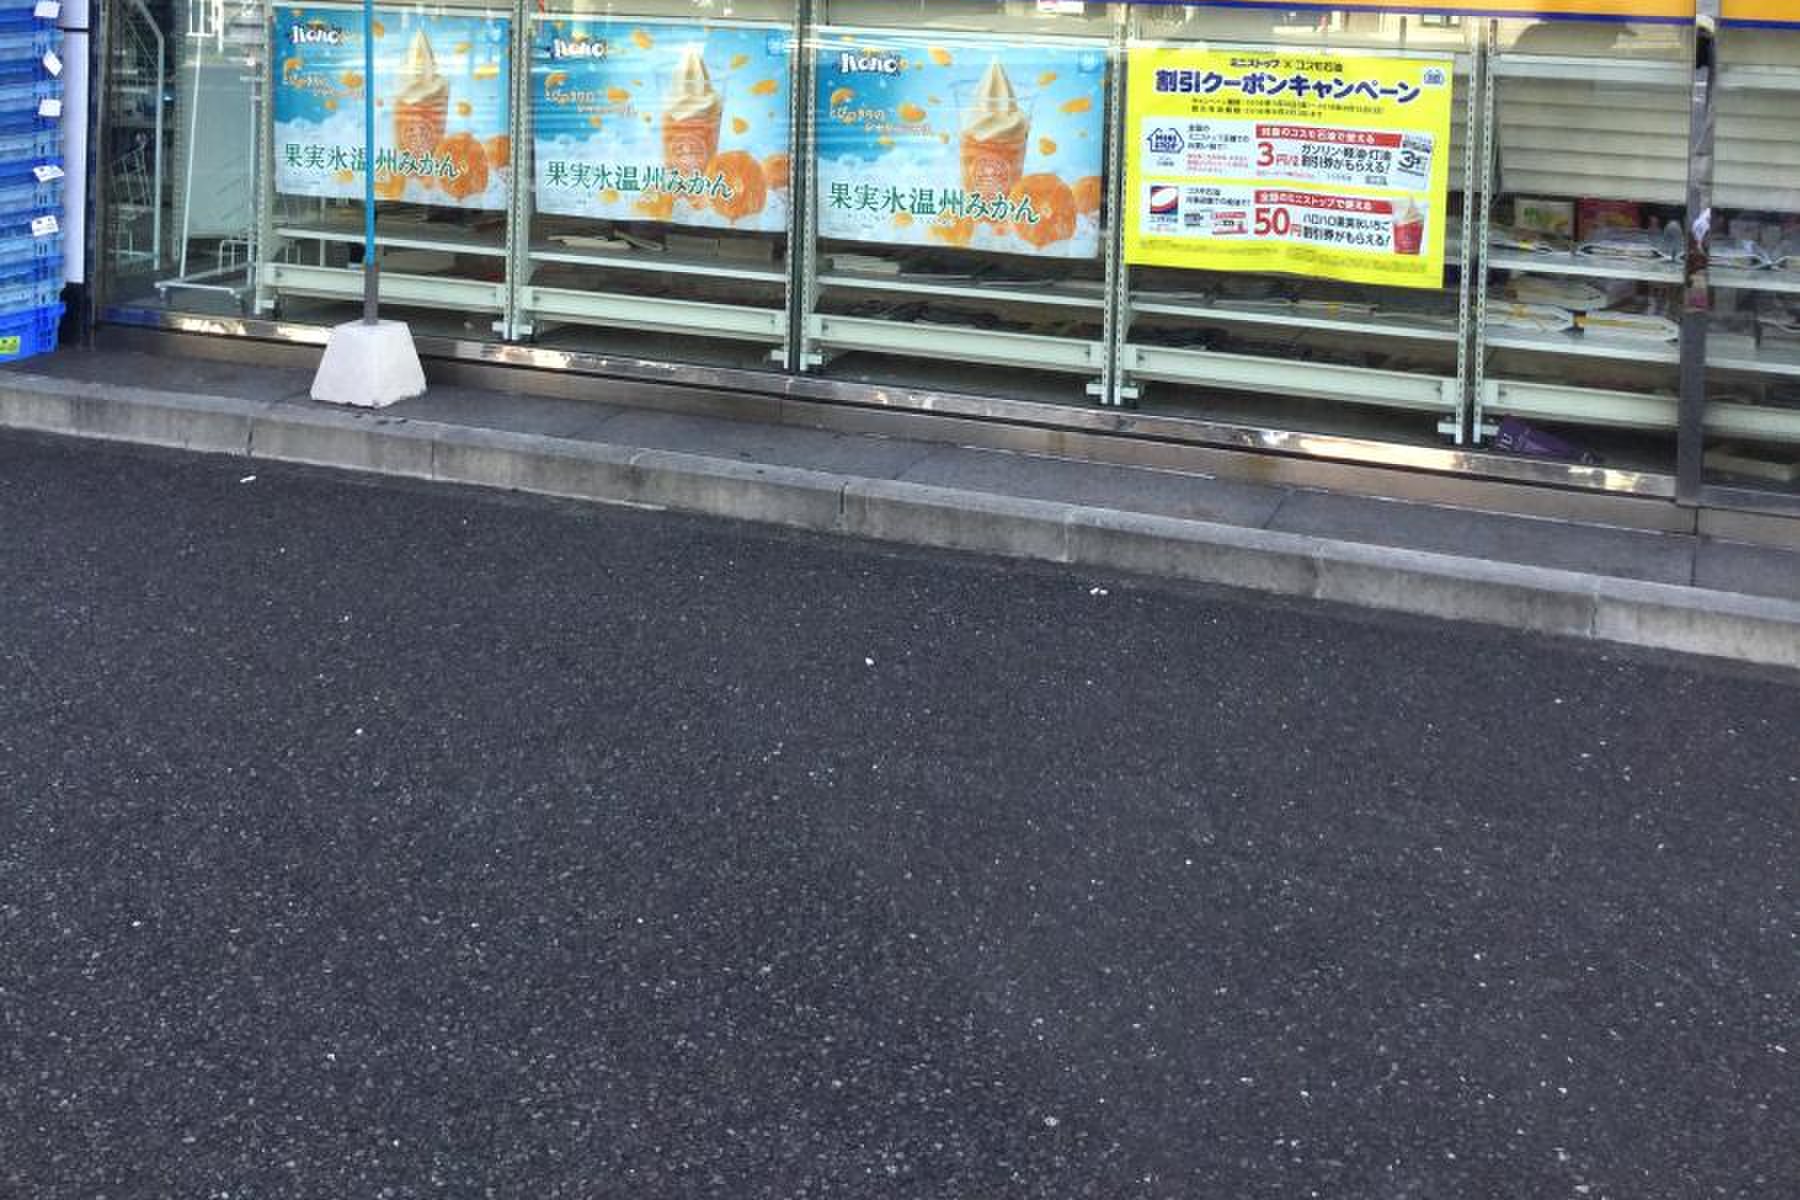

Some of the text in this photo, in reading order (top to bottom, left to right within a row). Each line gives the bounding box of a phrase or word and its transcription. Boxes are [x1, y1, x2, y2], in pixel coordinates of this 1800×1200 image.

[1156, 69, 1421, 103] 割引クーポンキャンペーン
[285, 143, 459, 178] 果実氷温州みかん
[546, 161, 732, 199] 果実氷温州みかん
[830, 182, 1041, 224] 果実氷温州みかん
